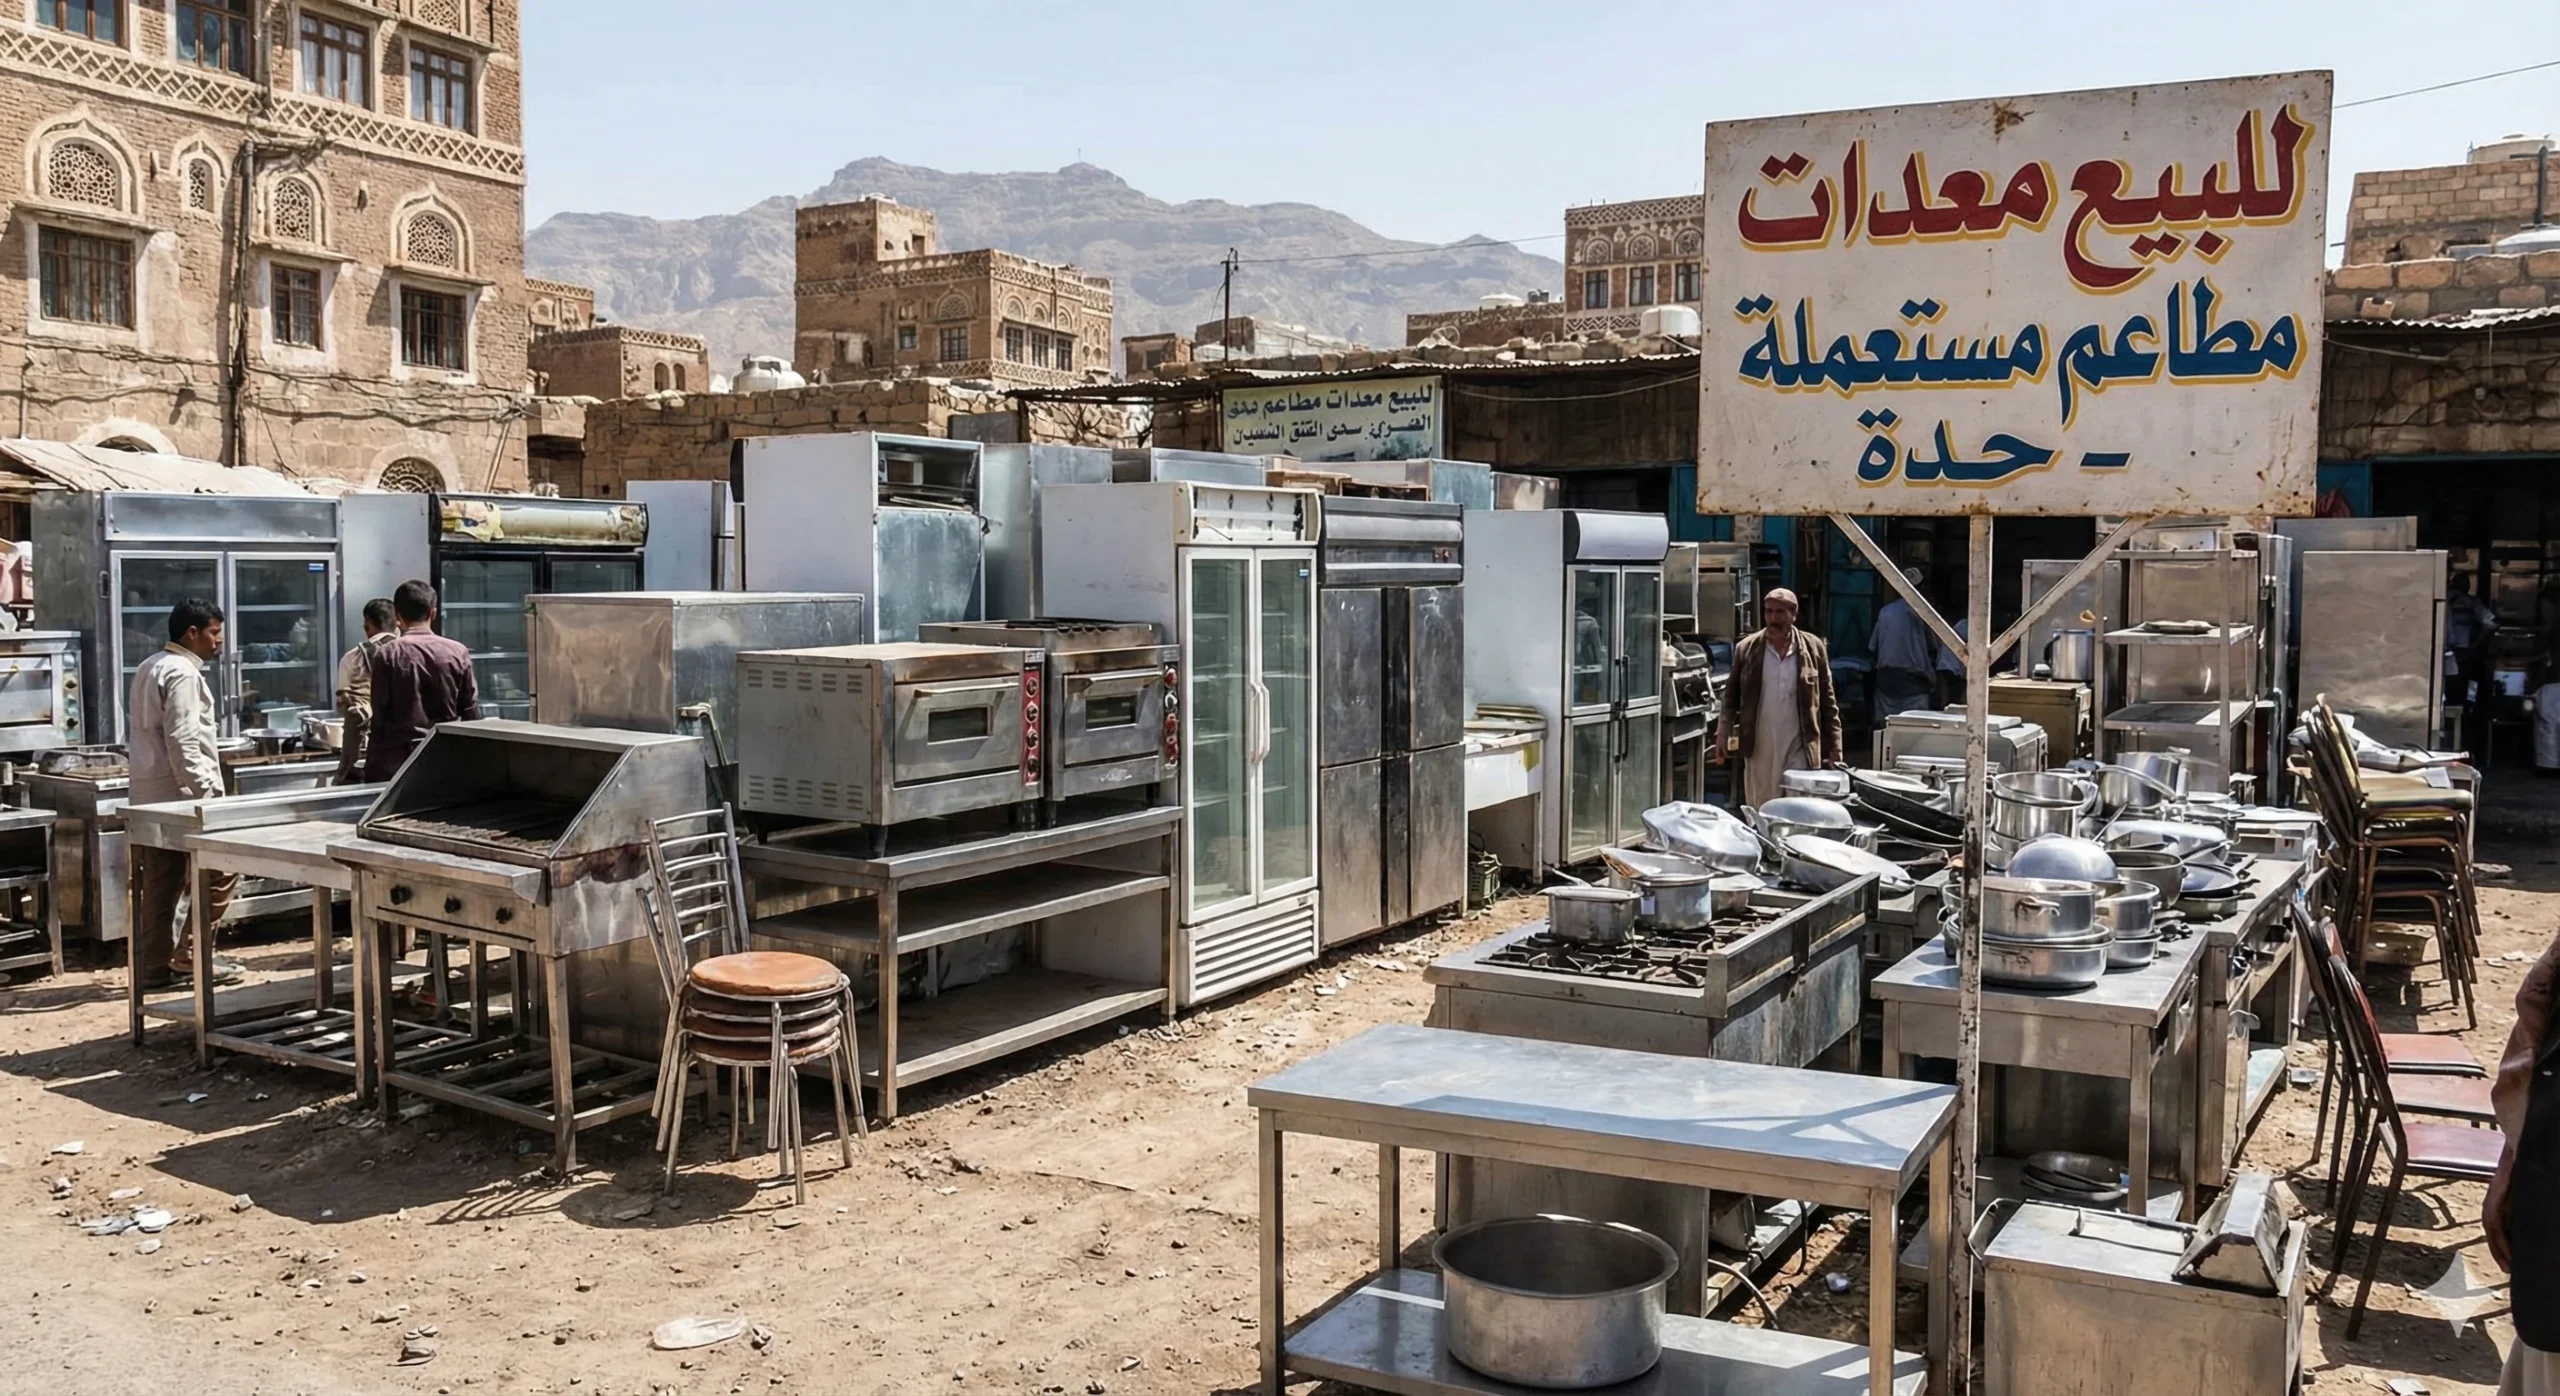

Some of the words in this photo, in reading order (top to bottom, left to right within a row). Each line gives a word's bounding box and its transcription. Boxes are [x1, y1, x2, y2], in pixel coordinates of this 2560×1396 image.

[1738, 138, 2059, 251] معدات
[2064, 103, 2314, 294] للبيع
[1735, 295, 2050, 398] مستعملة
[2057, 277, 2307, 430] مطاعم
[1263, 390, 1322, 420] مطاعم
[1326, 389, 1383, 409] معدات
[1388, 383, 1433, 414] للبيع
[1855, 407, 2062, 489] حدة
